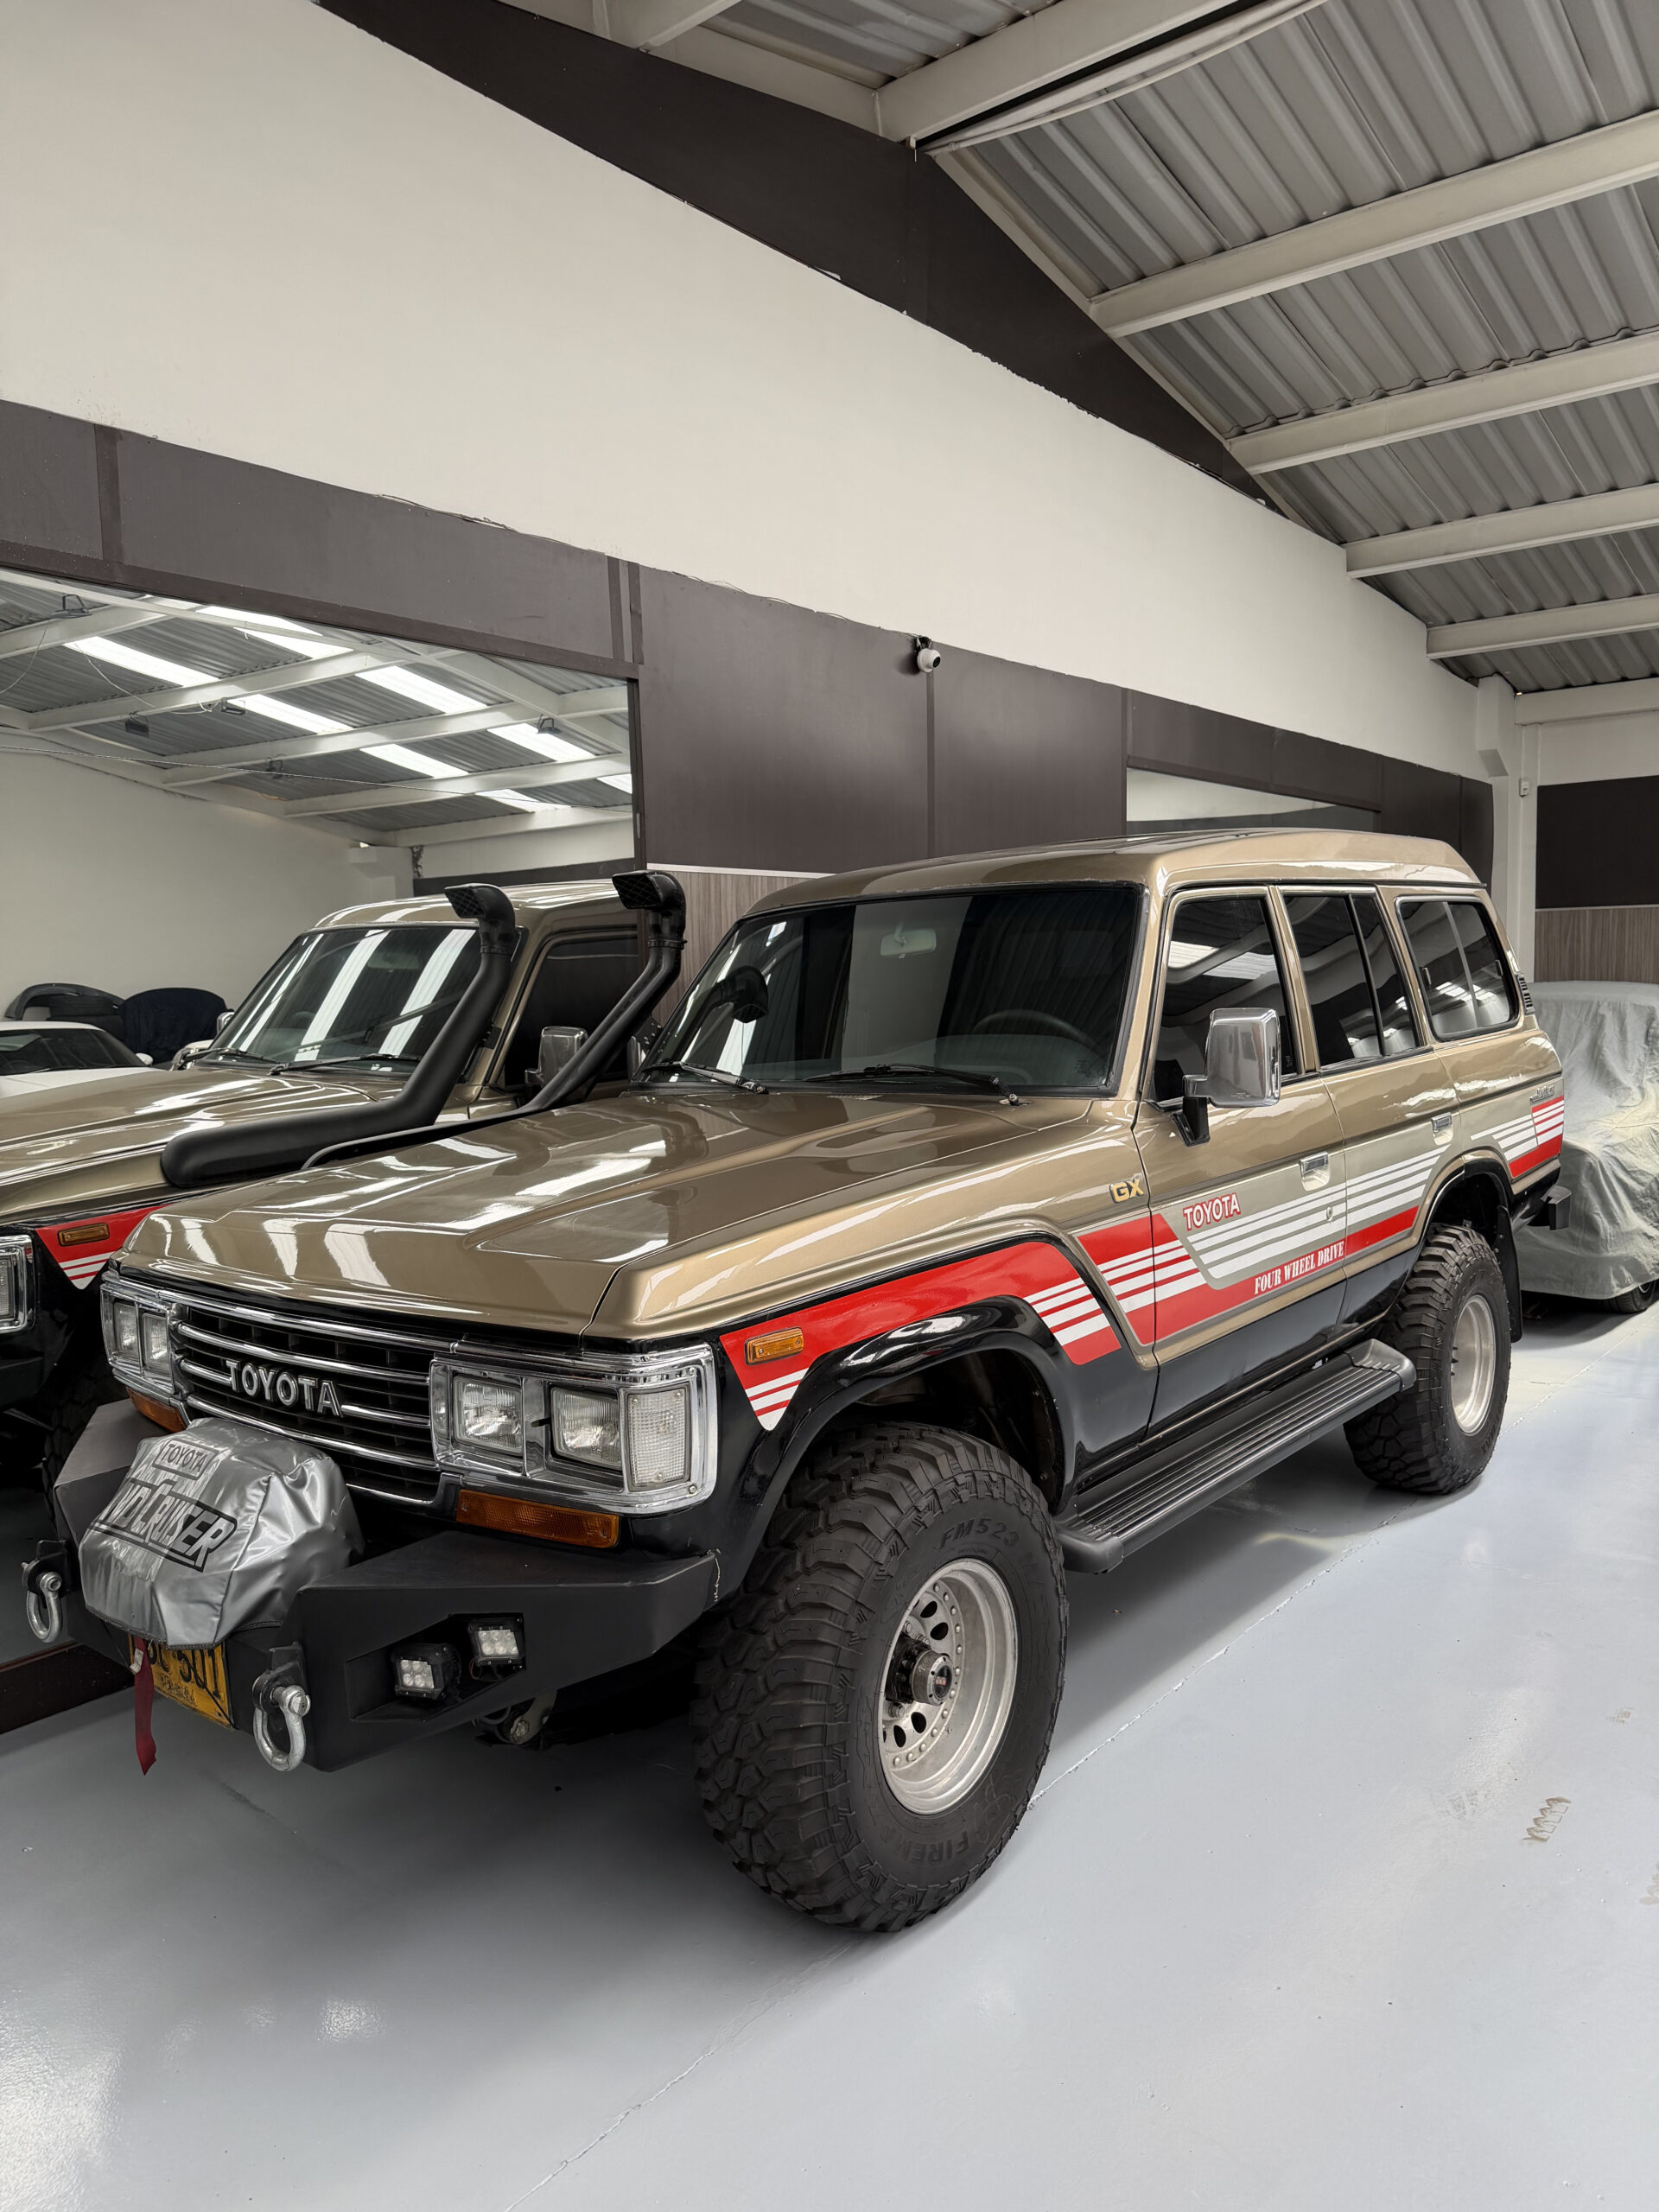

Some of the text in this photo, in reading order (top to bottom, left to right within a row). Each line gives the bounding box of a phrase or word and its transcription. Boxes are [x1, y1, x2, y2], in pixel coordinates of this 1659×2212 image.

[1109, 1178, 1145, 1204] GX
[1183, 1193, 1240, 1230] TOYOTA
[1254, 1241, 1344, 1294] FOUR WHEEL DRIVE
[226, 1359, 344, 1419] TOYOTA
[161, 1443, 209, 1472] TOYOTA
